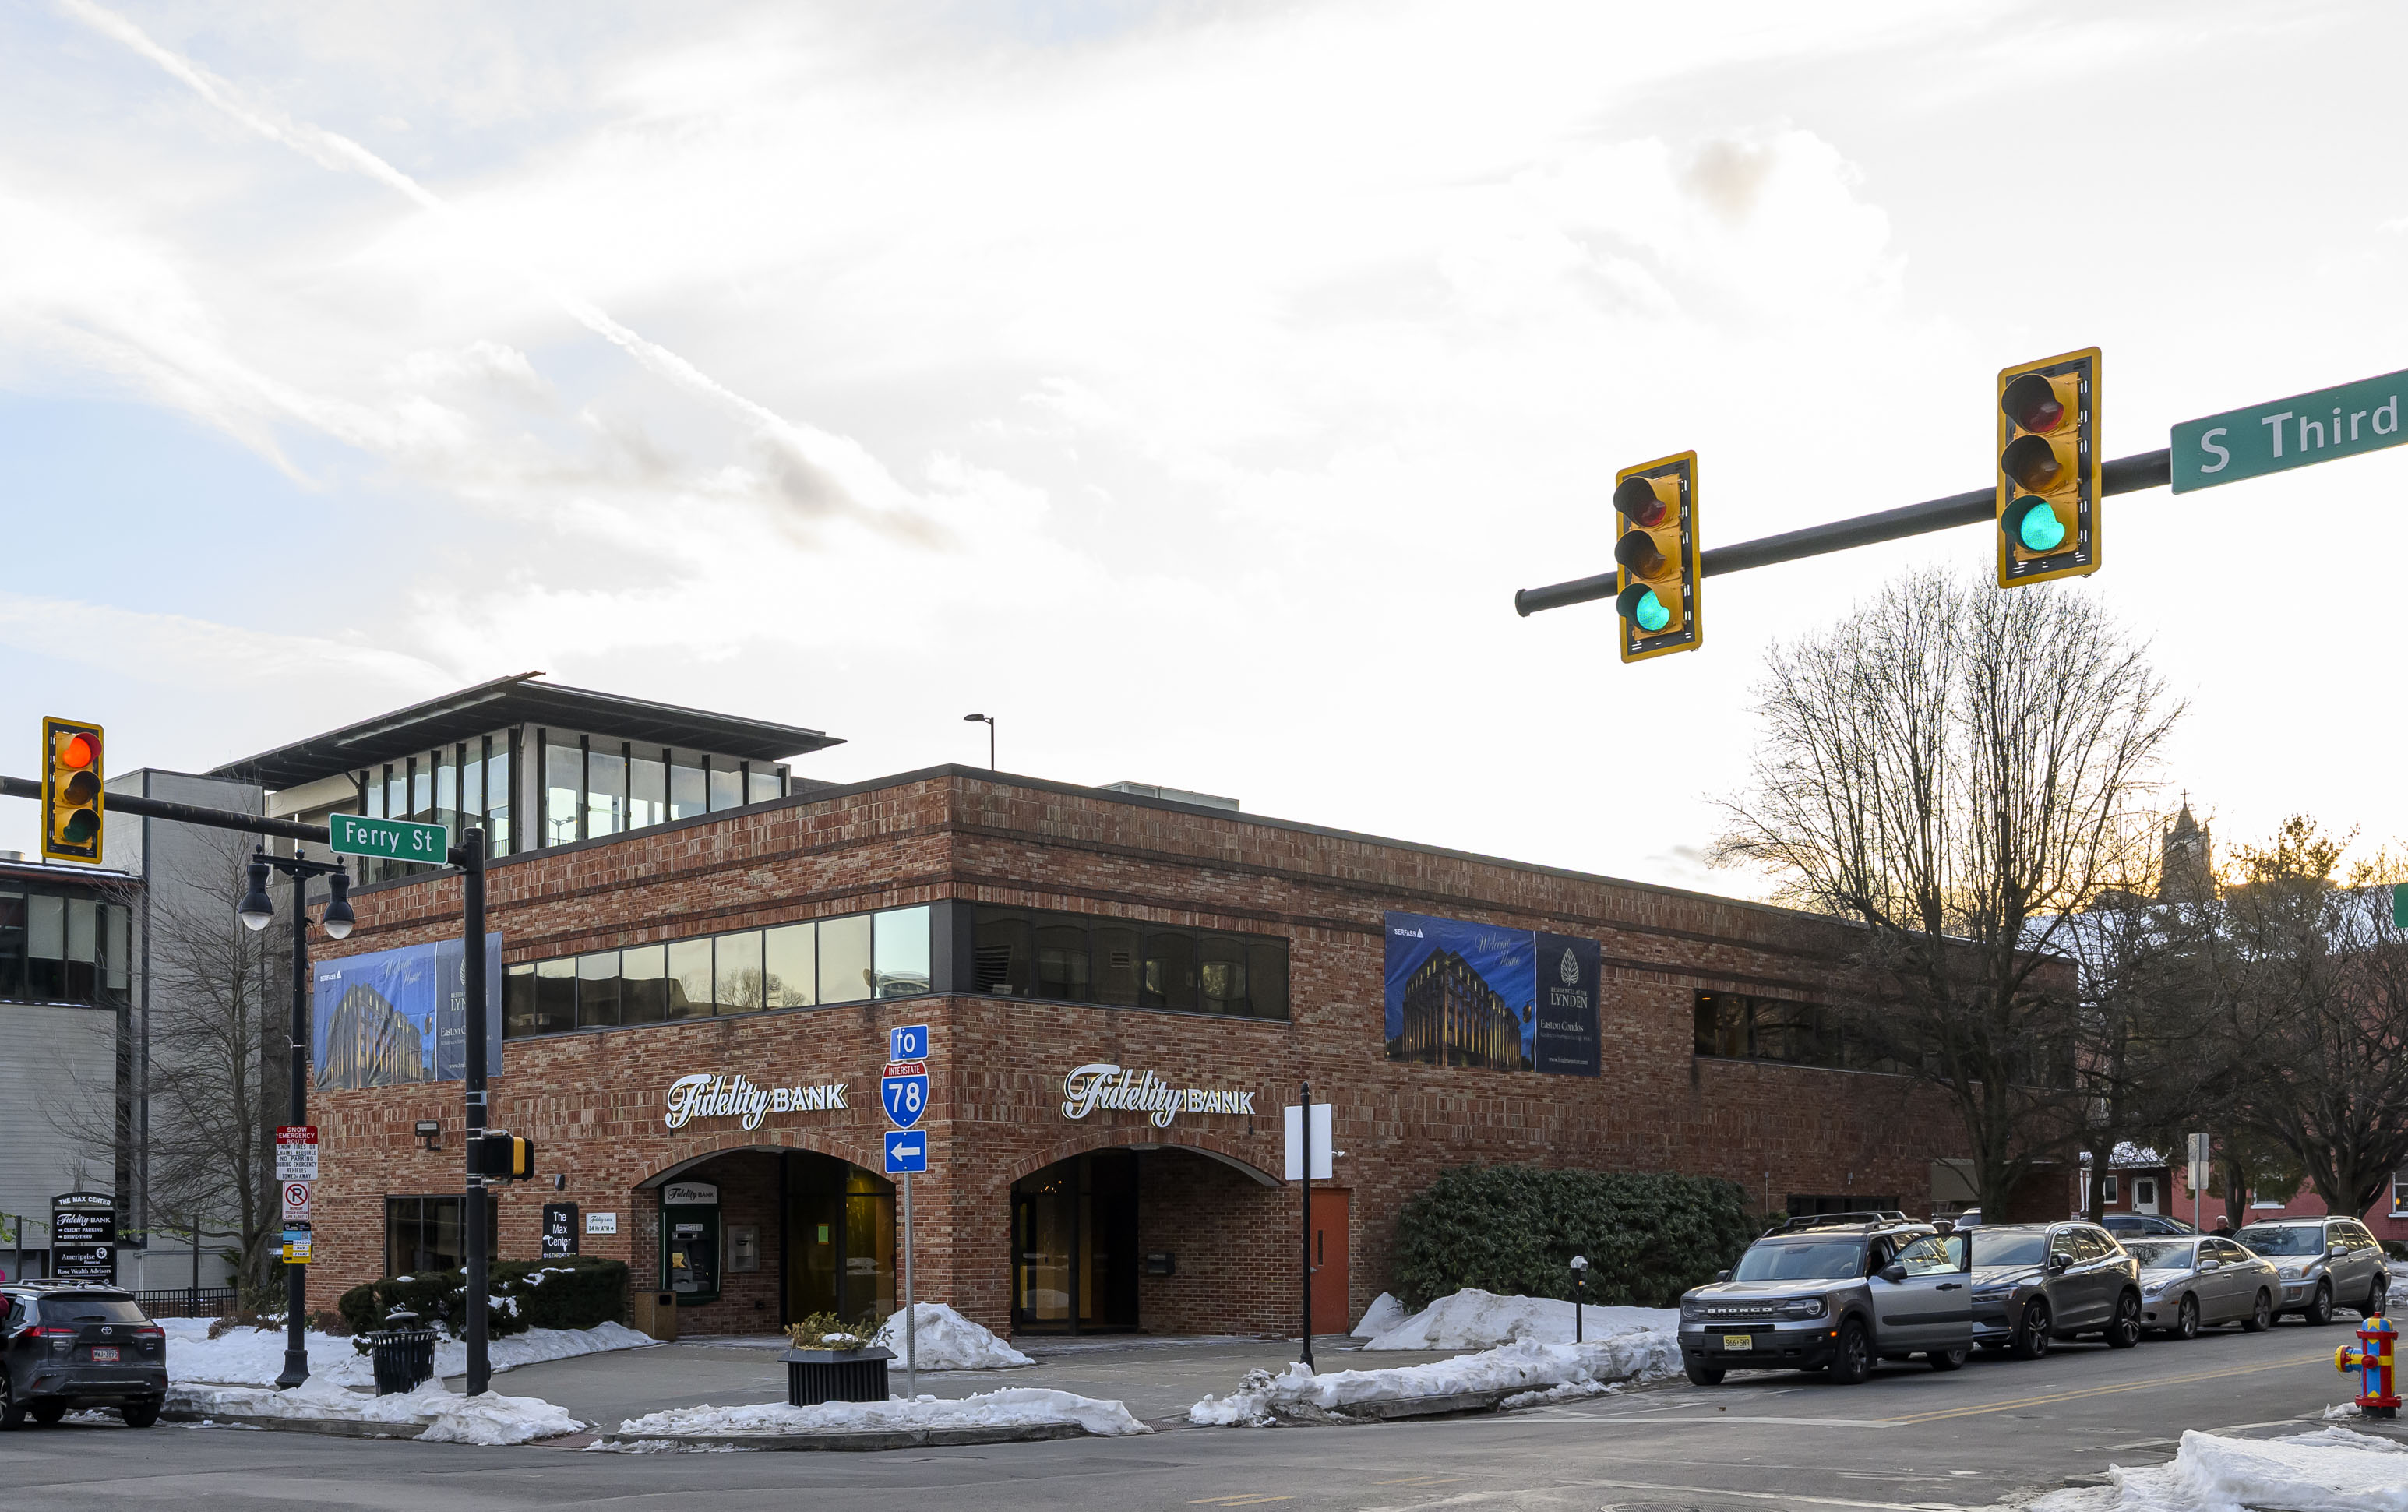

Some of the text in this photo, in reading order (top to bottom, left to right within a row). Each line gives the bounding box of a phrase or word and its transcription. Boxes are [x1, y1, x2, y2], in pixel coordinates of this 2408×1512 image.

[2200, 395, 2398, 474] S Third
[346, 821, 432, 853] Ferry St
[1394, 928, 1416, 938] SERFASS
[1475, 932, 1511, 953] Welcome
[1496, 950, 1521, 967] Home
[1550, 992, 1588, 1009] LYNDEN
[440, 1027, 460, 1037] Easton
[1540, 1019, 1584, 1033] Easton Condos
[888, 1065, 921, 1076] INTERSTATE
[665, 1073, 848, 1130] Fidelity BANK
[888, 1082, 921, 1112] 78
[1063, 1063, 1256, 1129] Fidelity BANK
[668, 1188, 697, 1201] Fidelity
[58, 1197, 71, 1206] THE
[88, 1197, 111, 1206] CENTER
[56, 1214, 89, 1227] Fidelity
[553, 1211, 567, 1222] The
[590, 1215, 604, 1224] Fidelity
[552, 1224, 568, 1235] Max
[548, 1236, 572, 1246] Center
[62, 1253, 96, 1262] Ameriprise
